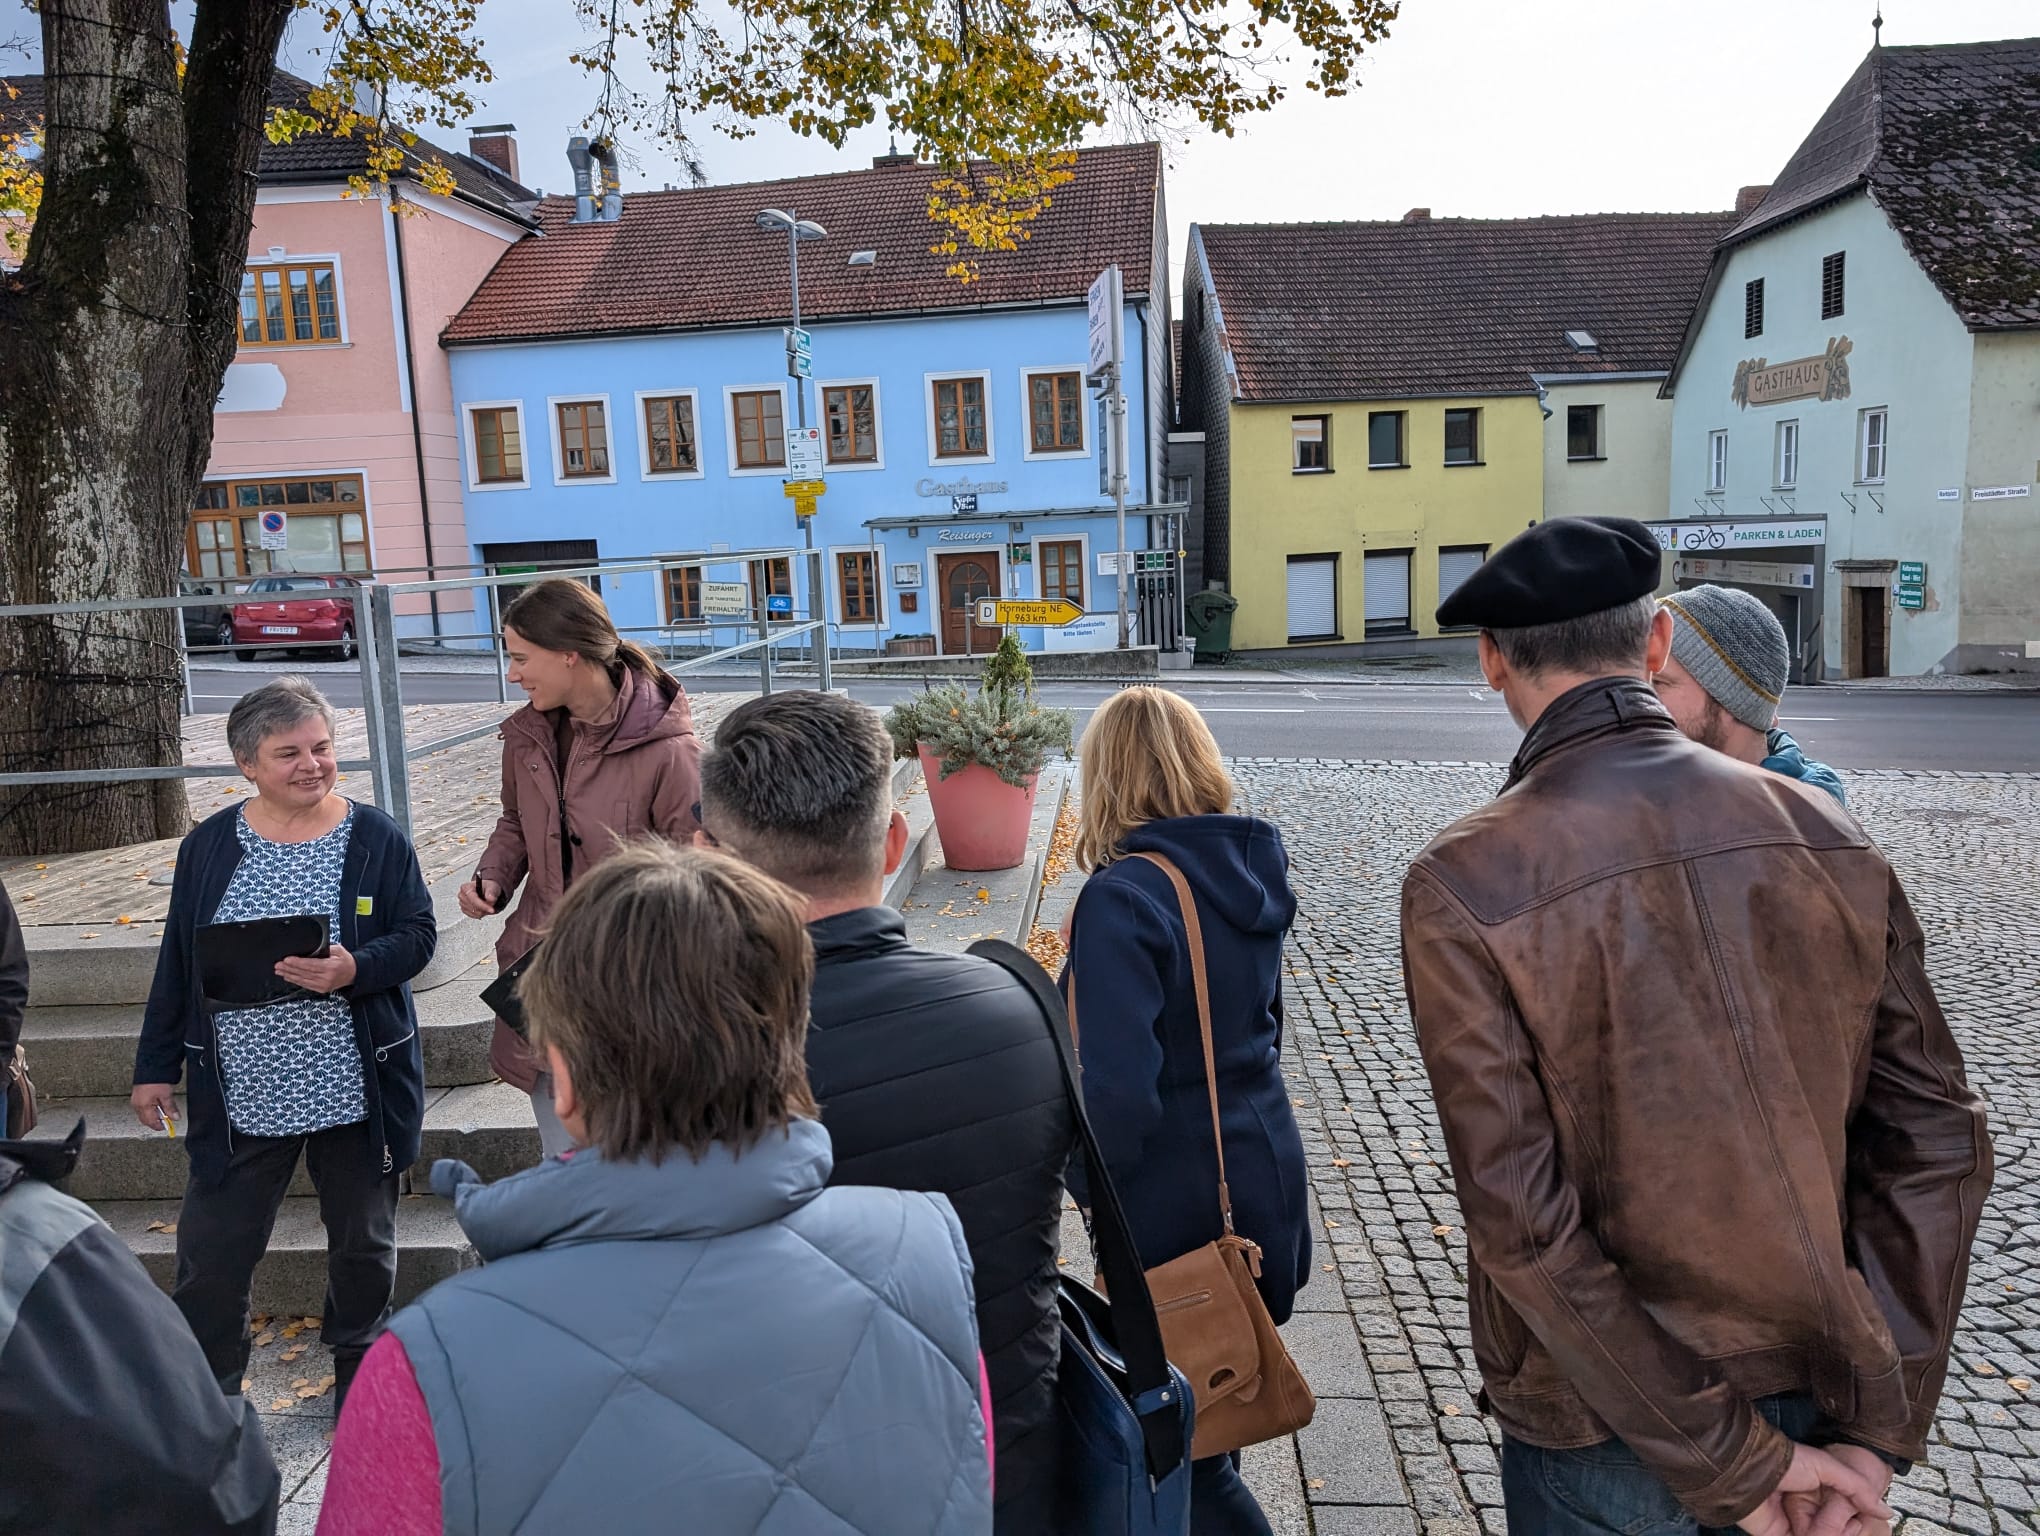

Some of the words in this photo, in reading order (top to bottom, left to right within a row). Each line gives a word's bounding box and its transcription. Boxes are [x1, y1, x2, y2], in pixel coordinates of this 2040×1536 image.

[1754, 364, 1820, 392] GASTHAUS
[916, 476, 1008, 497] Gasthaus
[1974, 490, 2006, 498] Freistädter
[938, 529, 993, 542] Reisinger
[1734, 530, 1775, 541] PARKEN
[1777, 530, 1785, 539] &
[1787, 528, 1822, 539] LADEN
[983, 606, 992, 618] D
[1000, 604, 1047, 613] Horneburg
[1050, 604, 1062, 613] NE
[1015, 614, 1031, 622] 963
[1033, 614, 1047, 622] km
